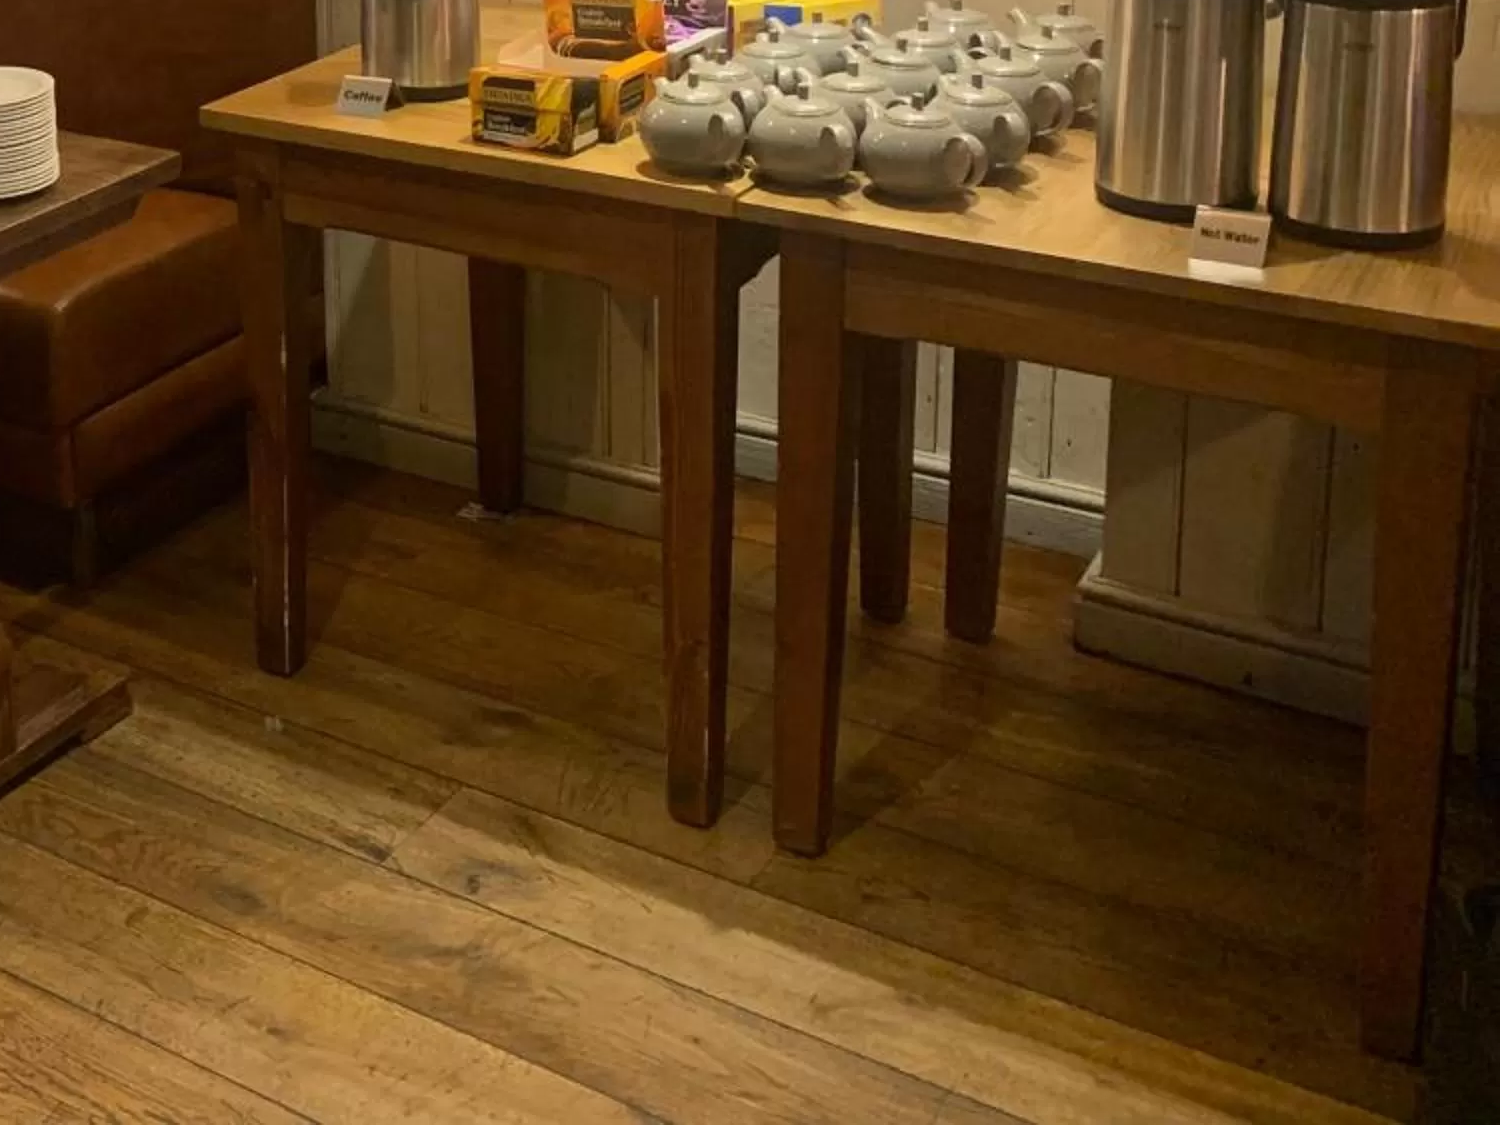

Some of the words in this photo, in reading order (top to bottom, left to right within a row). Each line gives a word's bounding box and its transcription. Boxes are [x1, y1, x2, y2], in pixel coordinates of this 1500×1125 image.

[344, 89, 383, 103] Coffee
[1201, 226, 1220, 240] Hot
[1224, 230, 1260, 245] Water
